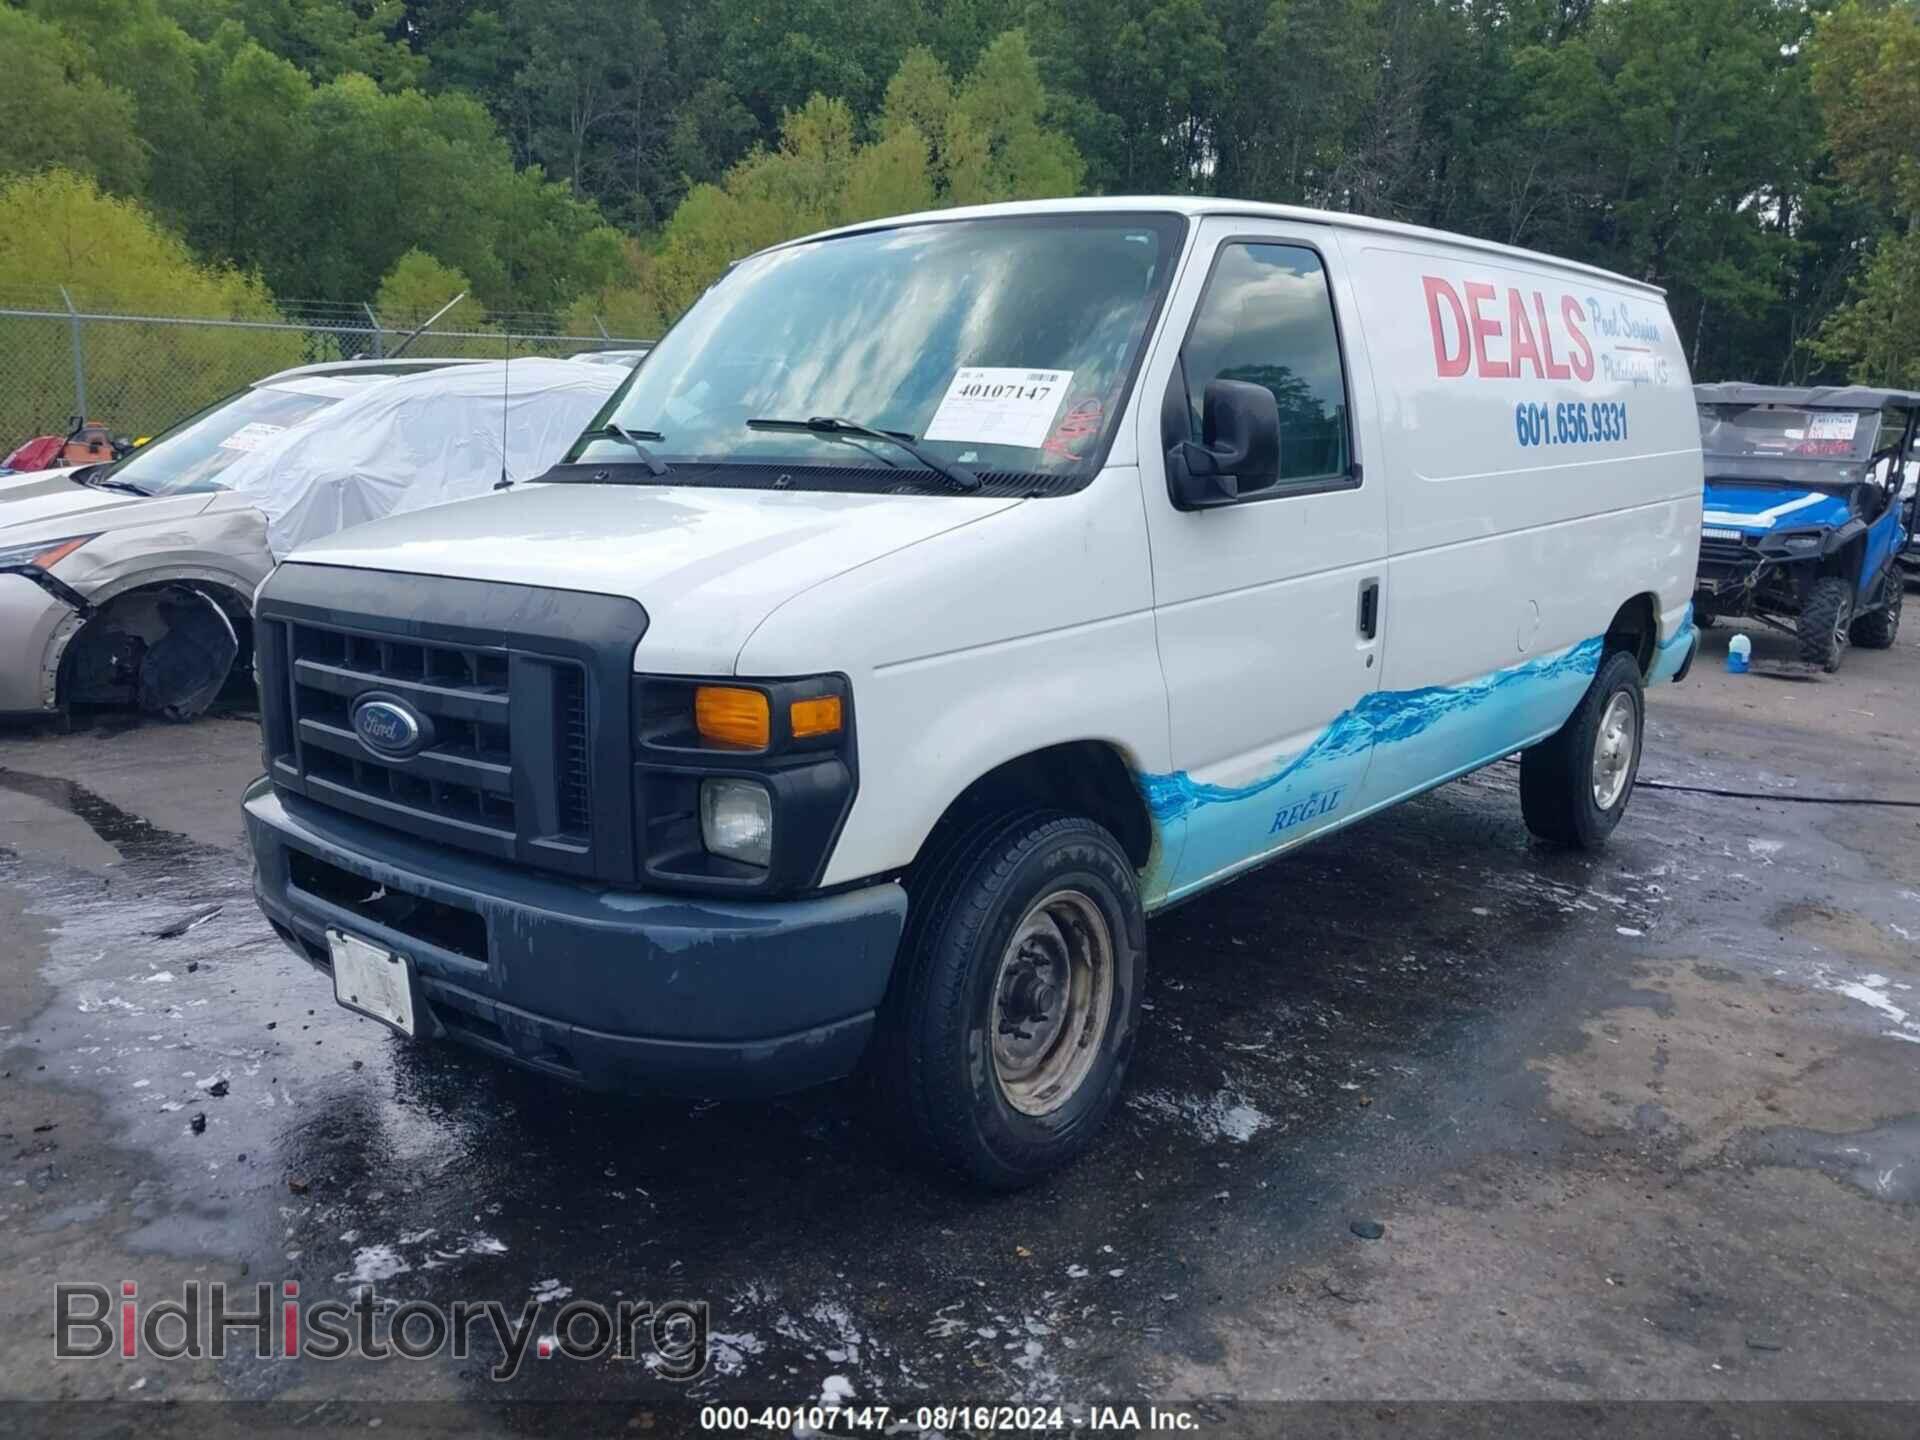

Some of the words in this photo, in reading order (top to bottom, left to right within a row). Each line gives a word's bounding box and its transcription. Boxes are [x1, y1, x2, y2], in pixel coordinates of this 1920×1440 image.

[1422, 275, 1594, 382] DEALS
[959, 384, 1051, 400] 40107147
[1515, 402, 1628, 446] 601.656.9331
[363, 708, 398, 738] Ford
